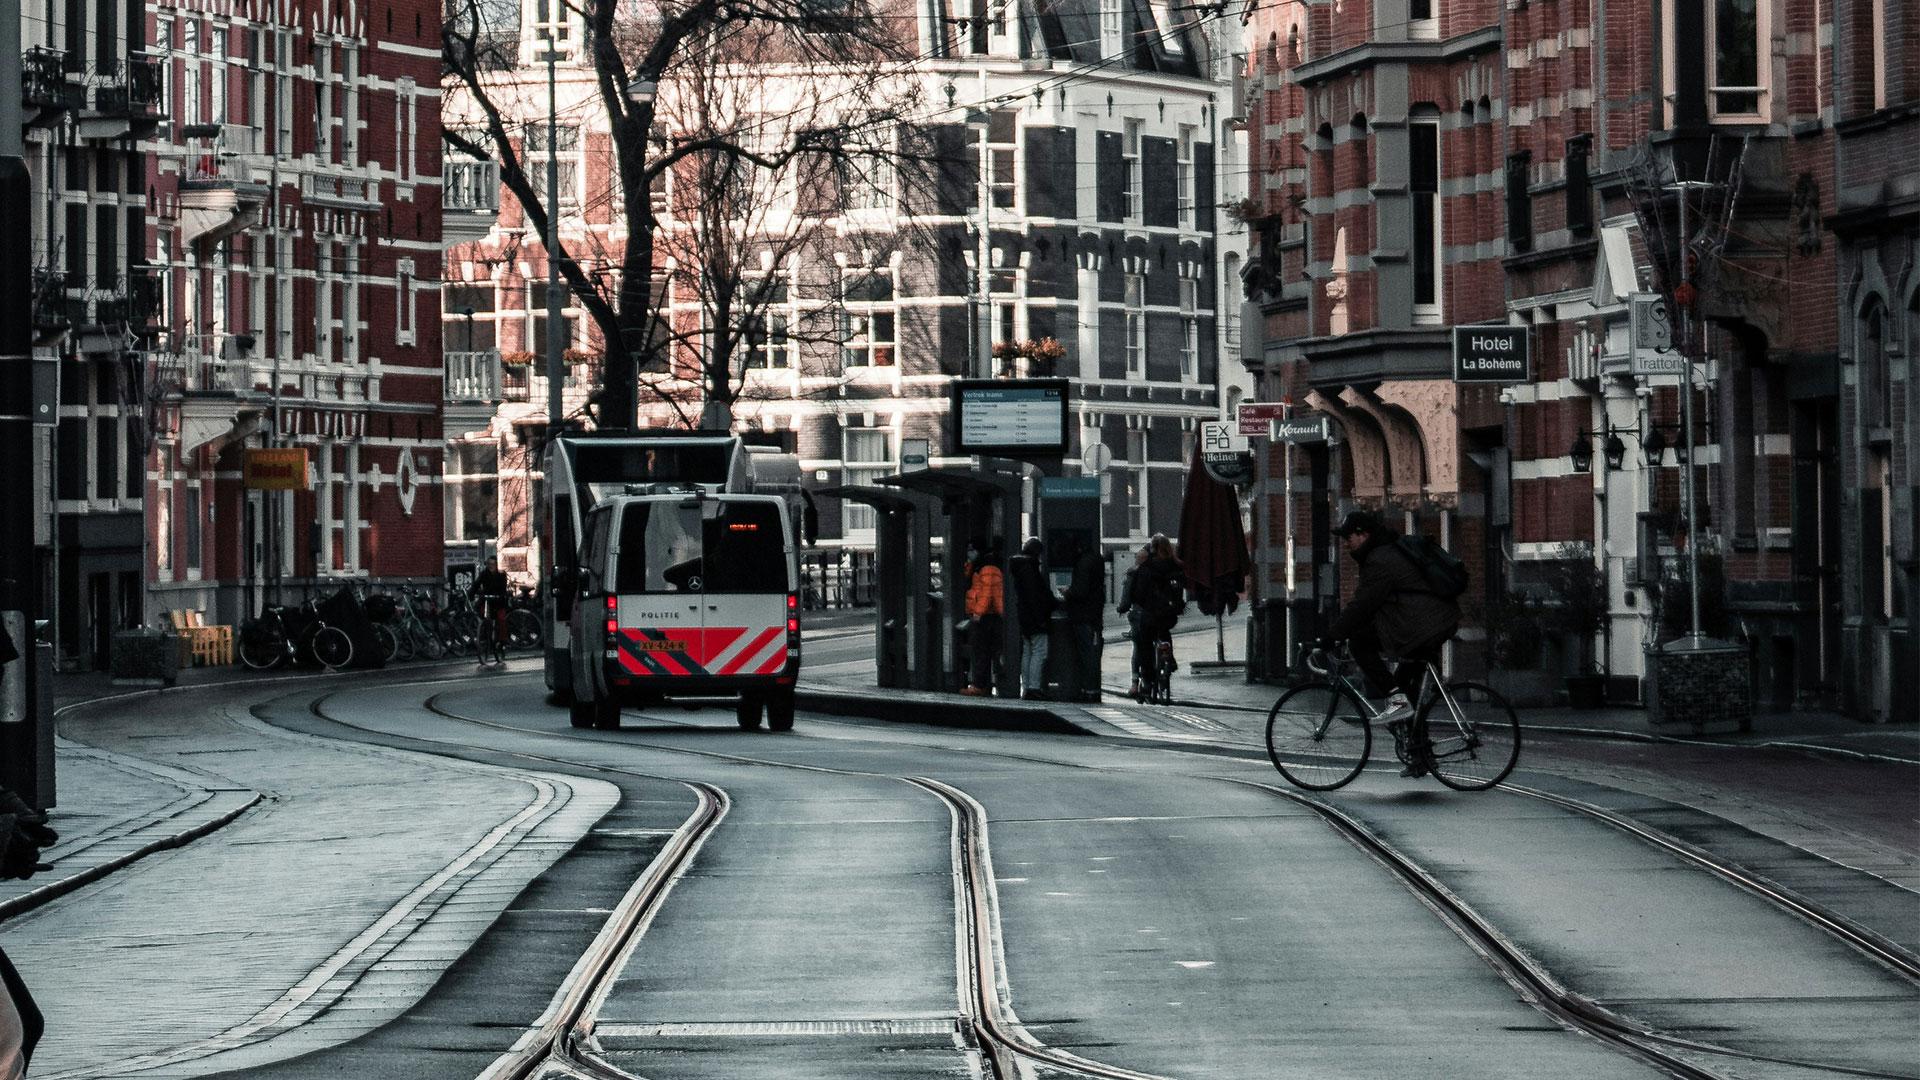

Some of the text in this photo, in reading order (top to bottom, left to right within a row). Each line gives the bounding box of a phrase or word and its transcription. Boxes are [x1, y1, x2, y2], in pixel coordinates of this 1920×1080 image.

[1472, 336, 1513, 350] Hotel
[1462, 358, 1522, 369] La Bohème
[1278, 423, 1320, 437] Kornuit
